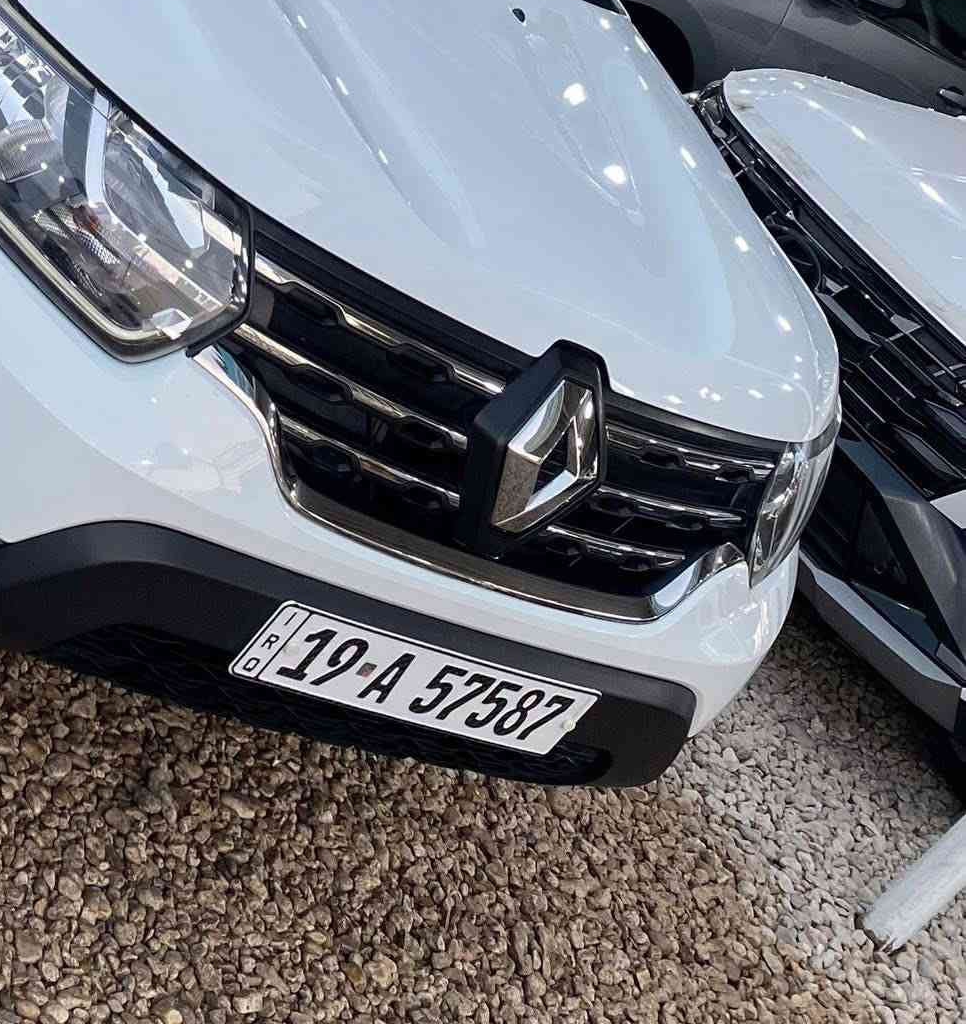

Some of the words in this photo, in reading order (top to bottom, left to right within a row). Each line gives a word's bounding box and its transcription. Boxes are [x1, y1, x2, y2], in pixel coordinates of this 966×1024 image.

[276, 629, 369, 686] 19
[357, 653, 415, 704] A
[409, 664, 575, 741] 57587
